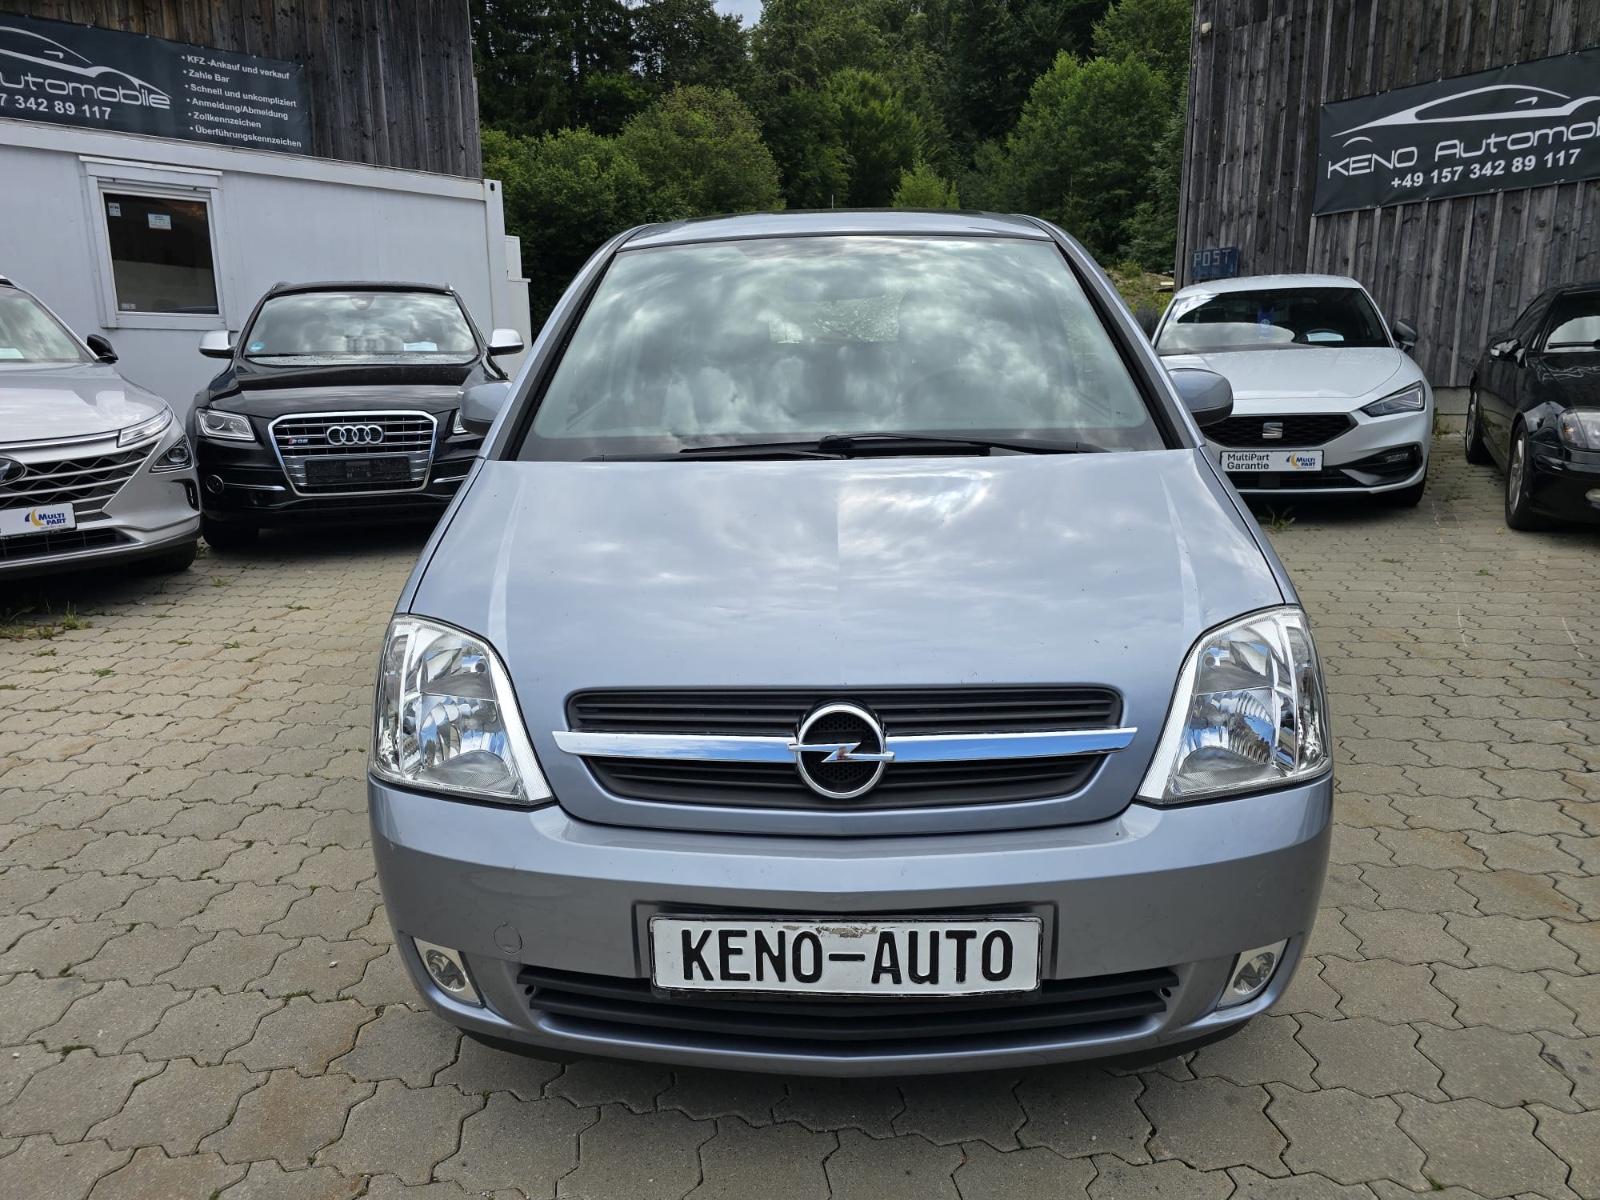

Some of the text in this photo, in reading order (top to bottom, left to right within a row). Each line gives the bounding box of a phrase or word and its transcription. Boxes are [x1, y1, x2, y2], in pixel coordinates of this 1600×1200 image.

[187, 54, 206, 65] KFZ
[242, 66, 258, 75] und
[260, 69, 290, 80] verkauf
[188, 69, 230, 83] Zahle Bar
[14, 95, 49, 112] 342
[54, 100, 76, 115] 89
[82, 104, 112, 120] 117
[190, 83, 297, 108] Schnell und unkompliziert
[191, 97, 289, 121] Anmeldung/Abmeldung
[193, 111, 262, 129] Zollkennzeichen
[1327, 146, 1418, 180] KENO
[1391, 148, 1582, 189] +49 157 342 89 117
[1193, 249, 1232, 267] POST
[1227, 453, 1270, 462] MultiPart
[1227, 461, 1270, 470] Garantie
[46, 518, 66, 526] PART
[681, 928, 1014, 985] KENO-AUTO
